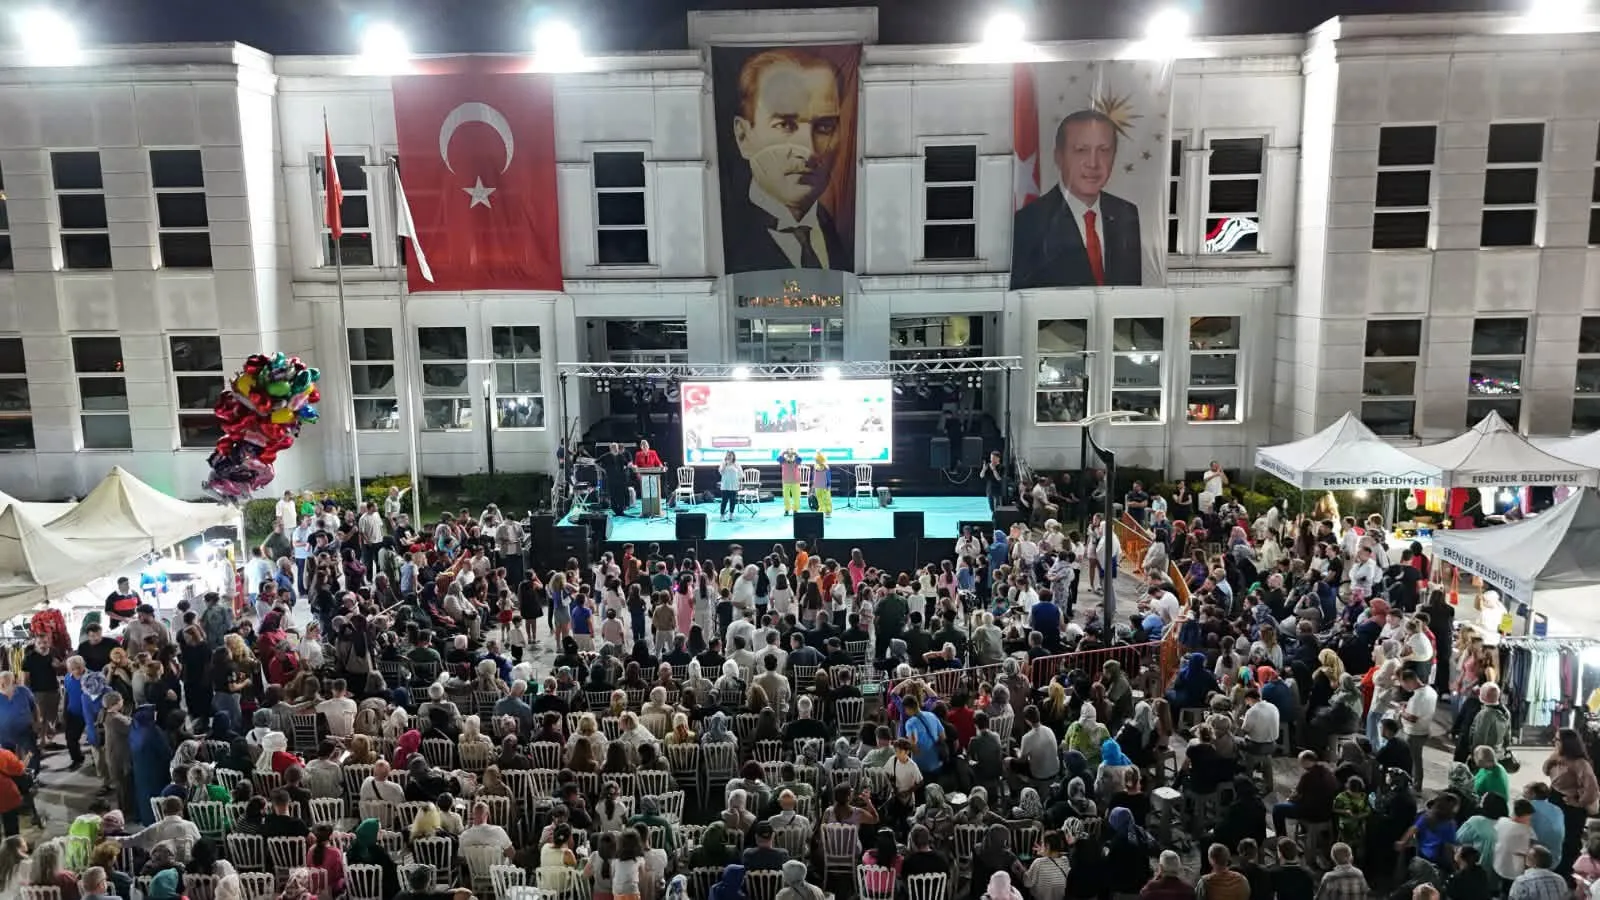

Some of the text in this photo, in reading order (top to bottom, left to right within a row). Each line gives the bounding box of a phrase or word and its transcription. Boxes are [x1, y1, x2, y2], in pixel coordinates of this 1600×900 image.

[1323, 477, 1369, 486] ERENLER
[1472, 475, 1517, 484] ERENLER
[1443, 547, 1474, 569] ERENLER
